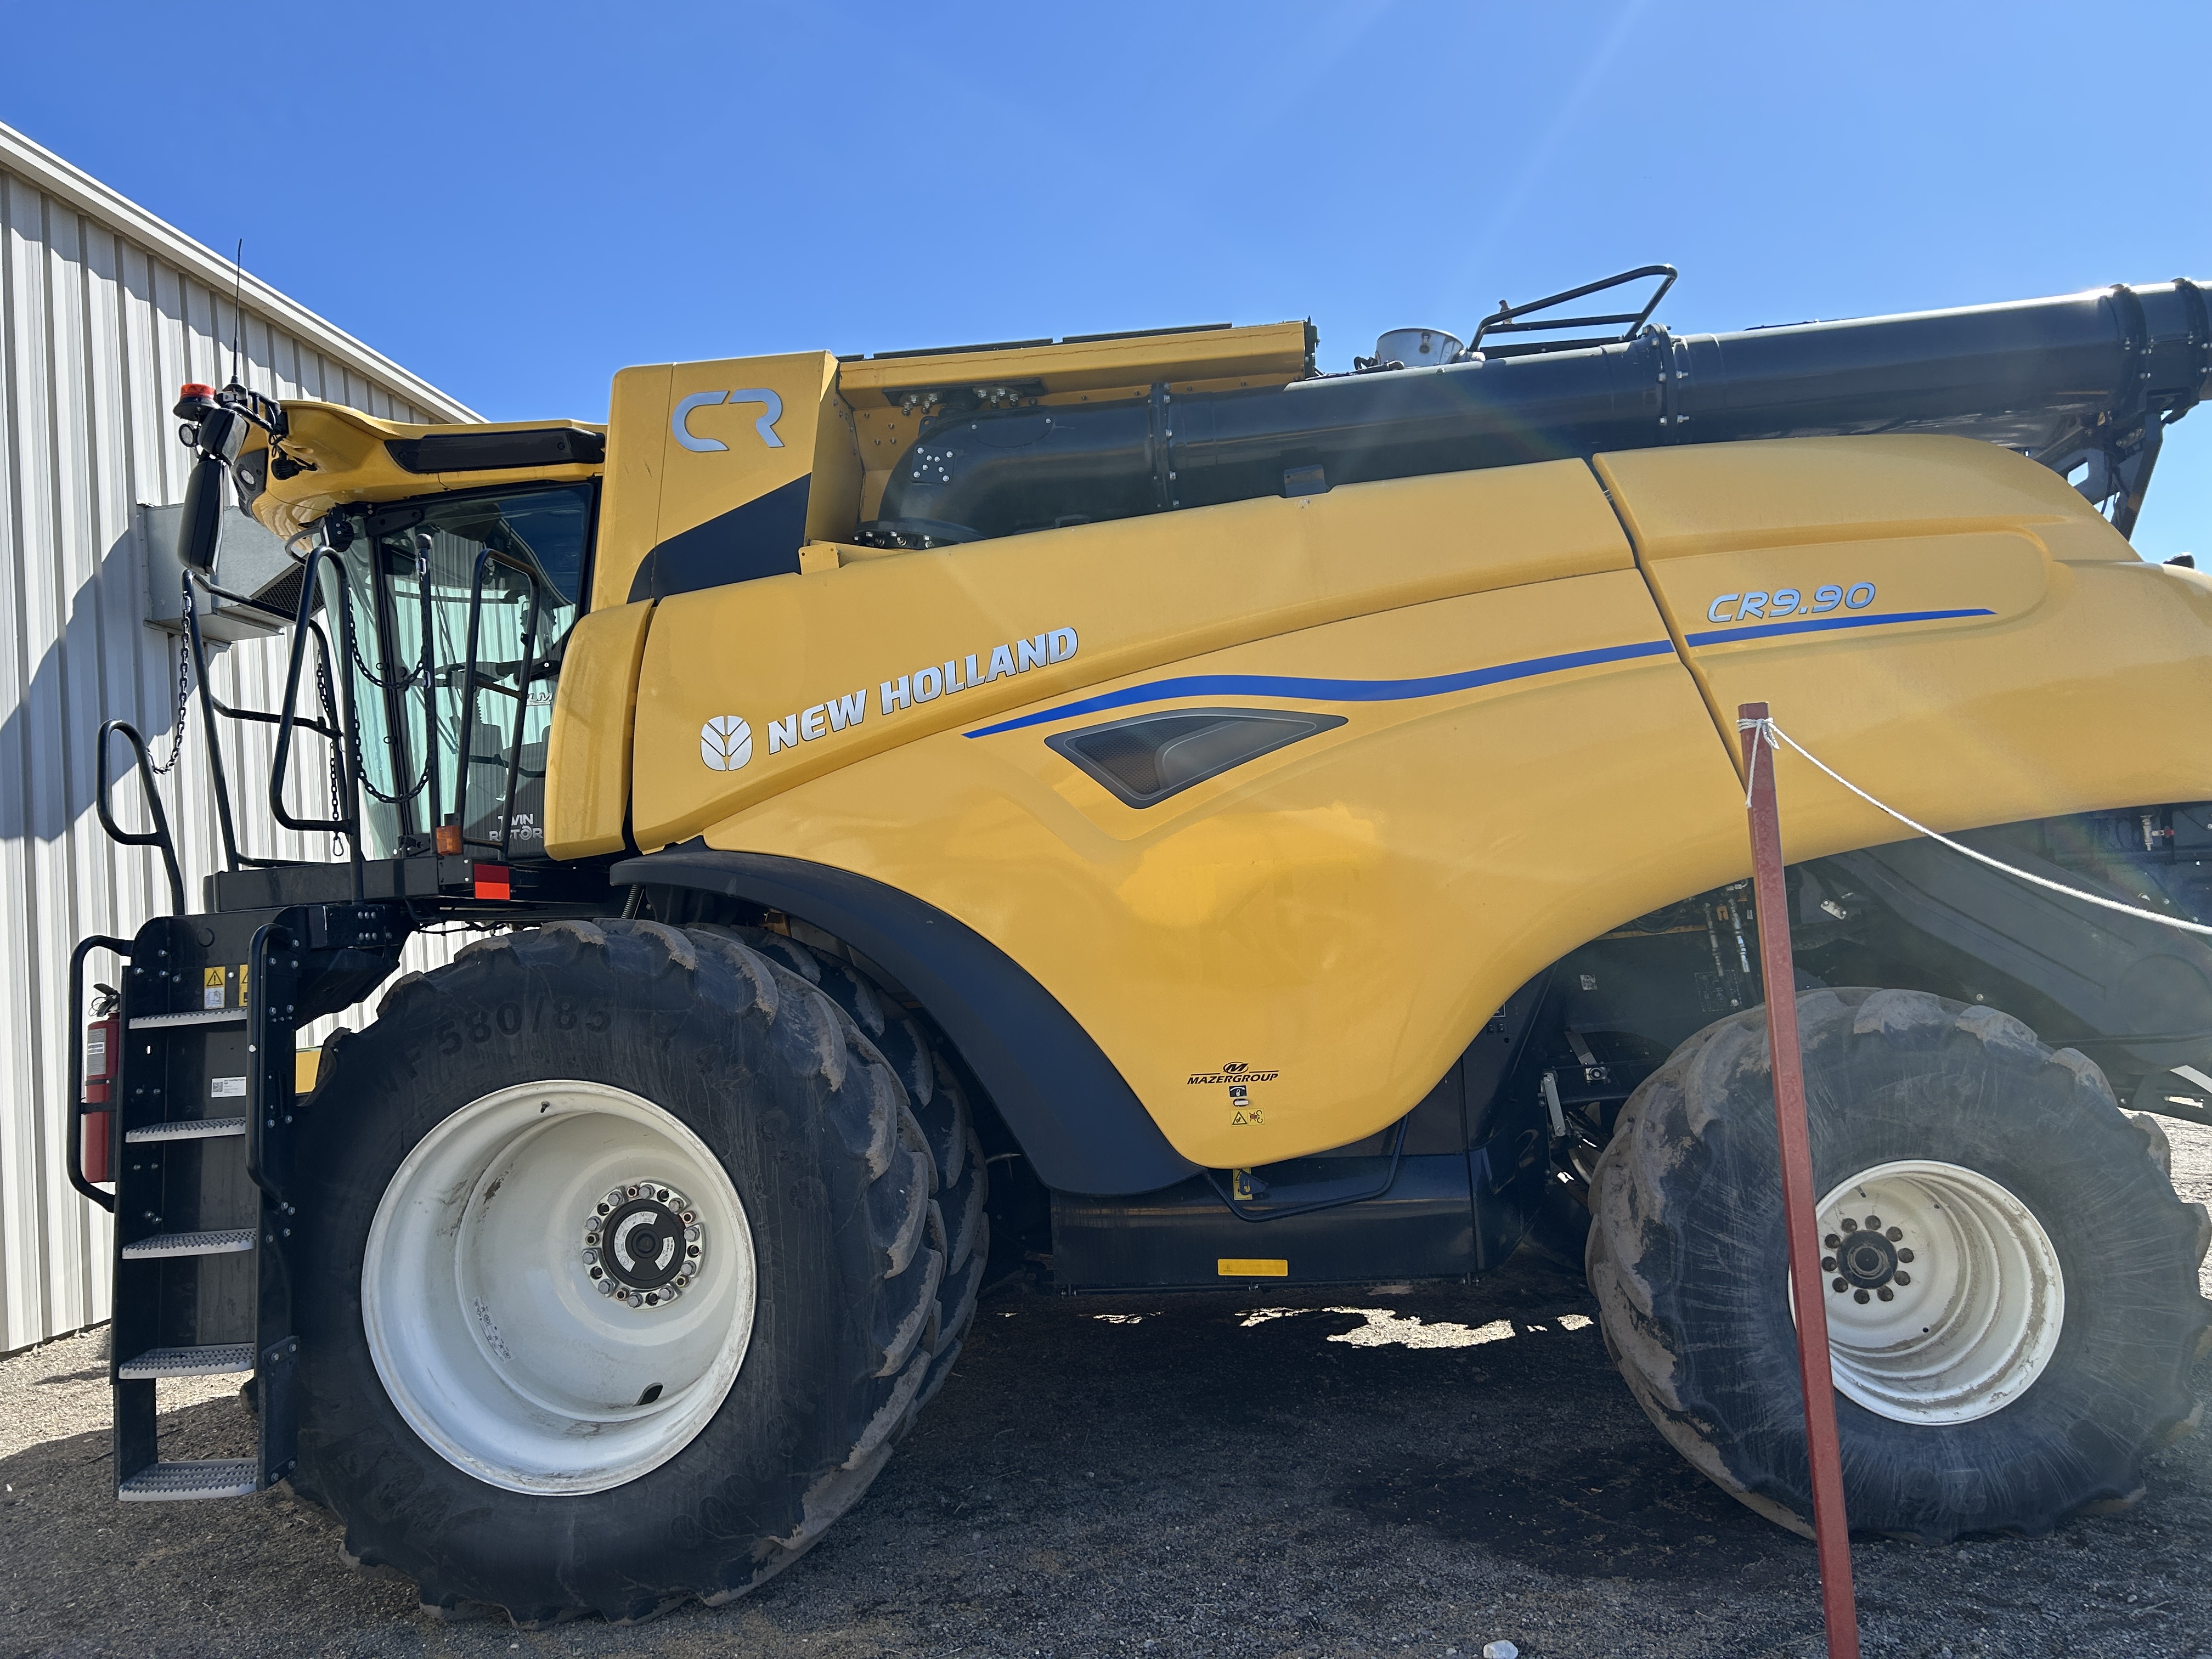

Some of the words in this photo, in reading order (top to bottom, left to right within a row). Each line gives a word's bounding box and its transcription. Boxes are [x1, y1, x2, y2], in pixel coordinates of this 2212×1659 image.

[672, 387, 785, 452] CR
[1707, 582, 1876, 623] CR9.90
[768, 689, 867, 754] NEW
[879, 627, 1079, 715] HOLLAND
[489, 826, 543, 842] RTOR
[439, 996, 612, 1056] 580/85
[1187, 1074, 1279, 1085] MAZERGROUP
